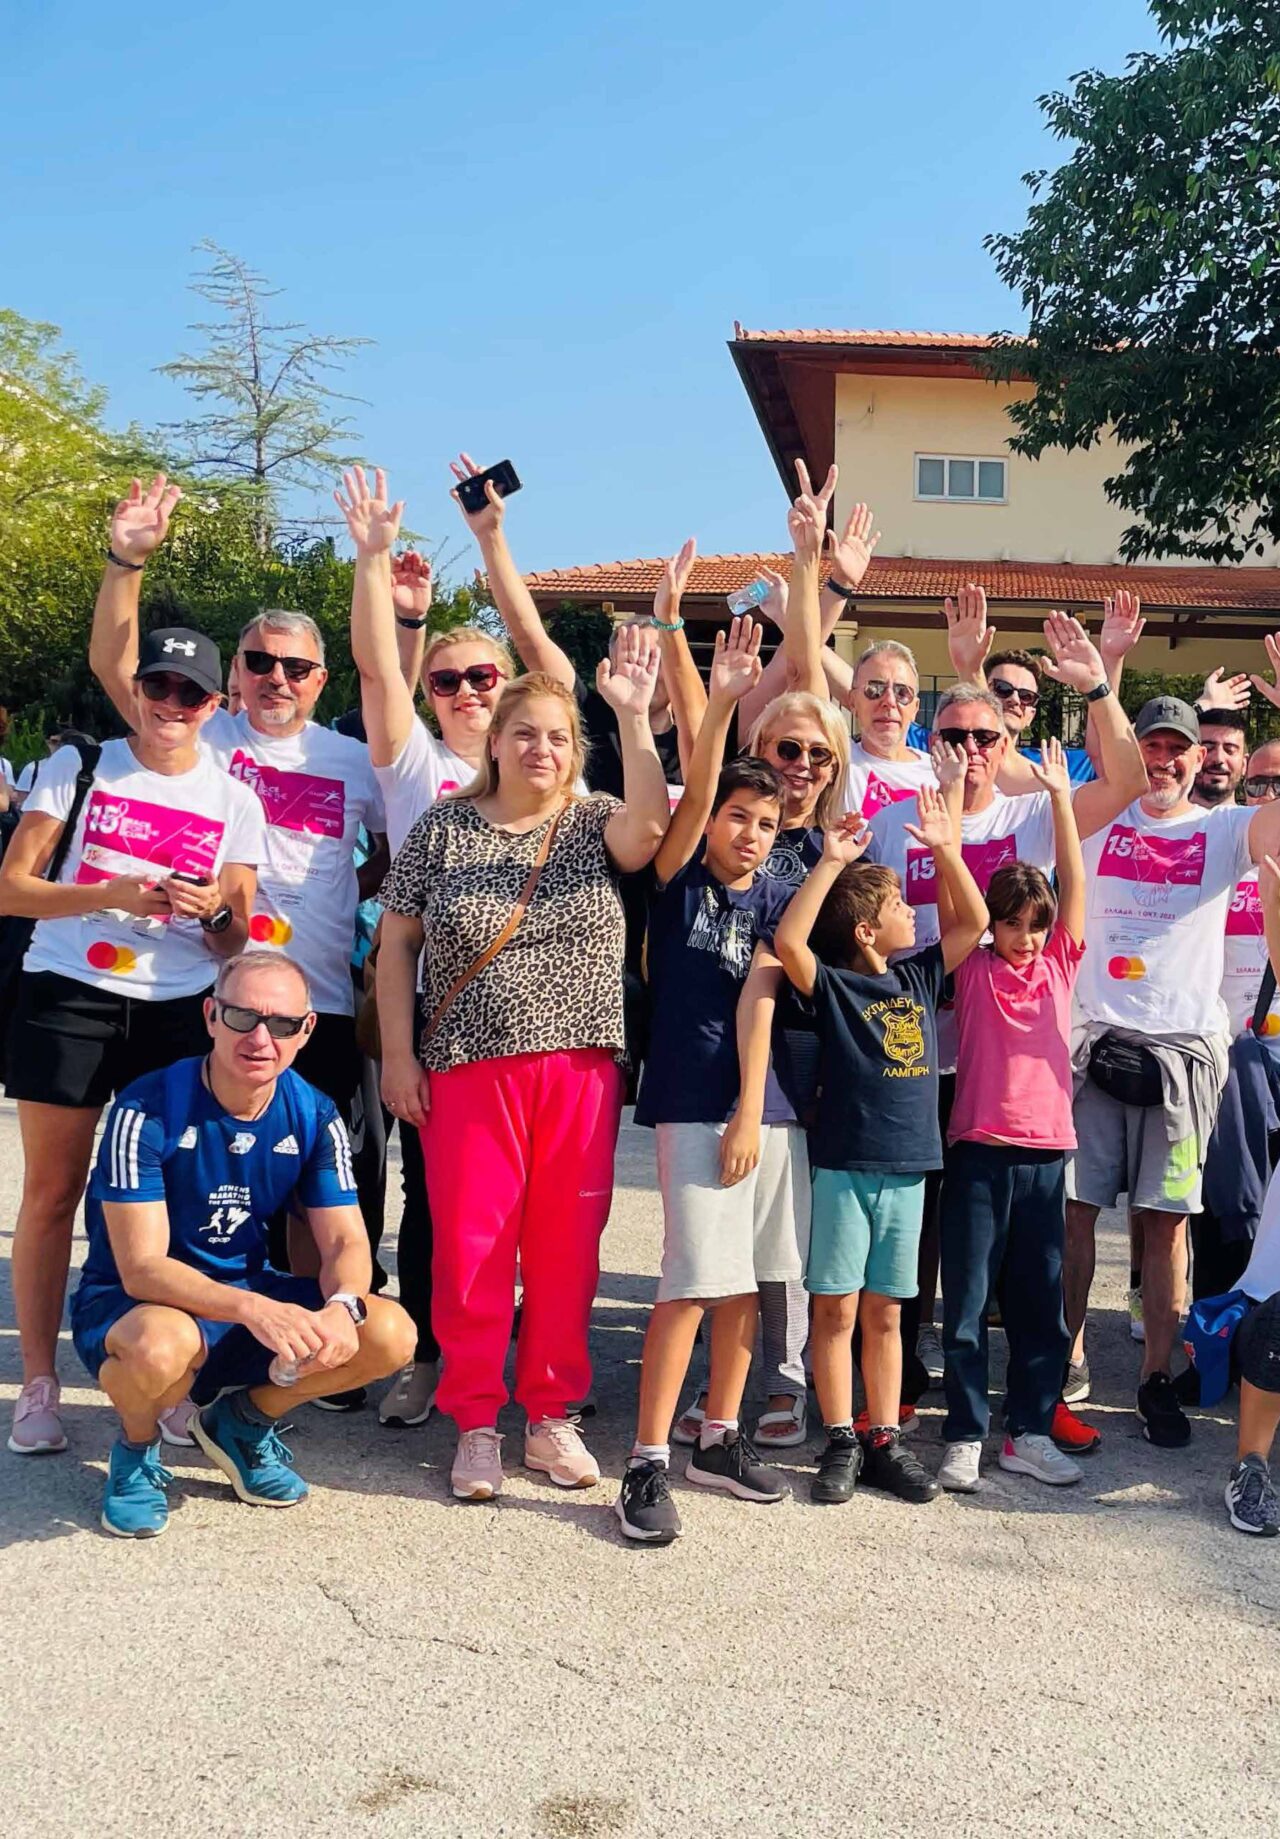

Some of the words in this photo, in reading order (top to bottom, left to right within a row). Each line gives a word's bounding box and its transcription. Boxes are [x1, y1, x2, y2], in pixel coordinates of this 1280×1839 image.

[89, 804, 120, 834] 15
[1106, 835, 1134, 857] 15
[908, 857, 937, 880] 15
[882, 1066, 929, 1077] ΛΑΜΠΙΡΗ
